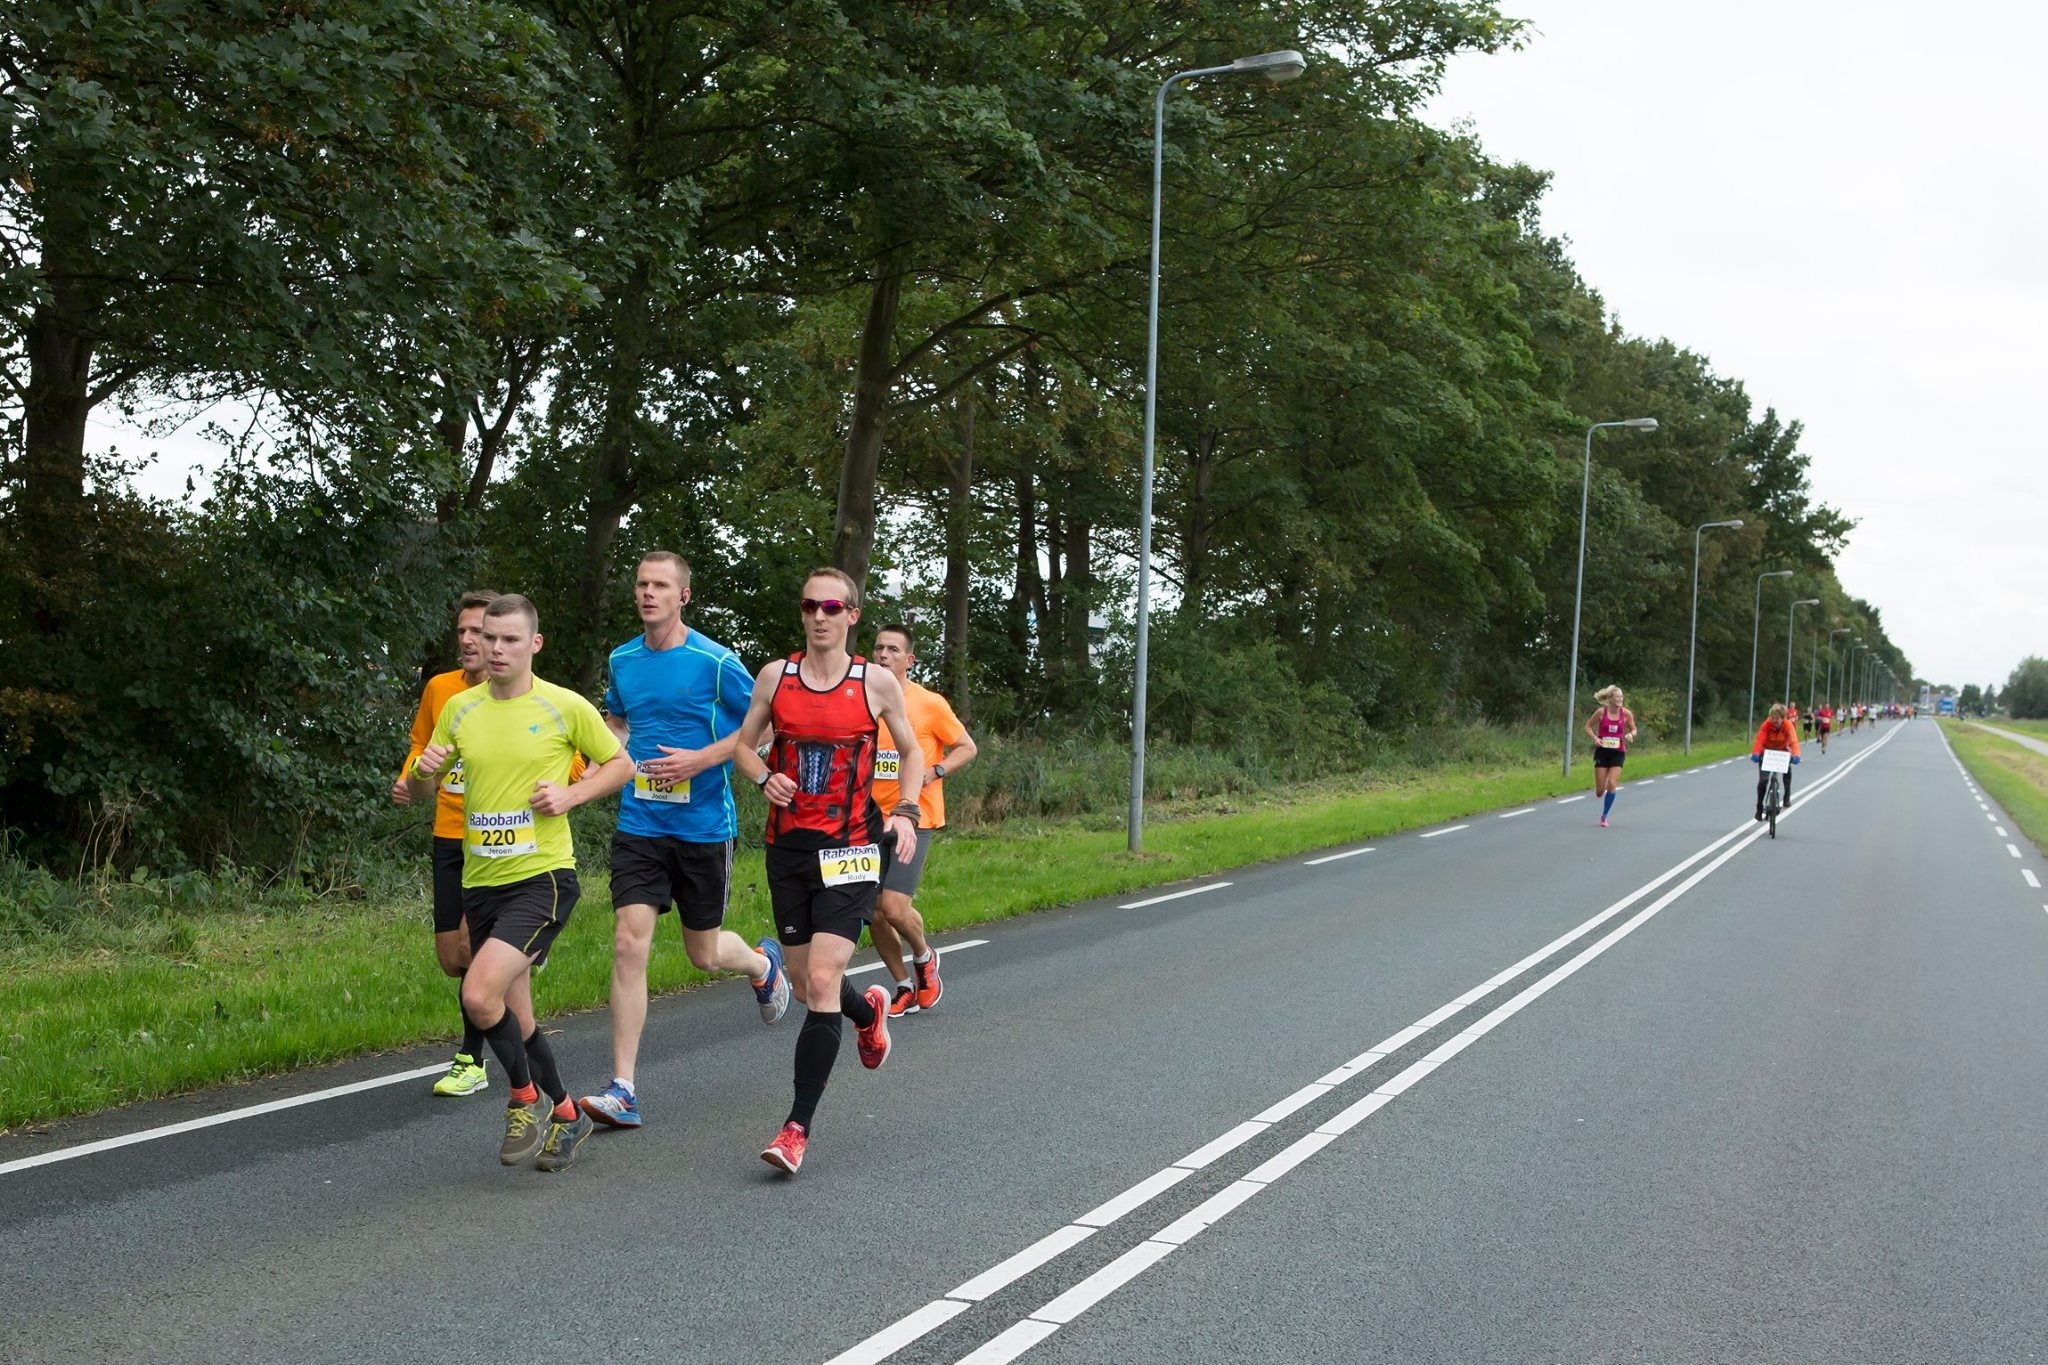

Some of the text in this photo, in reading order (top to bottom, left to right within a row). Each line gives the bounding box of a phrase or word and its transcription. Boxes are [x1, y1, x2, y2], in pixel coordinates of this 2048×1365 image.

[875, 761, 897, 773] 196
[450, 771, 464, 785] 24
[469, 811, 530, 827] Rabobank
[481, 829, 516, 848] 220
[838, 857, 871, 875] 210
